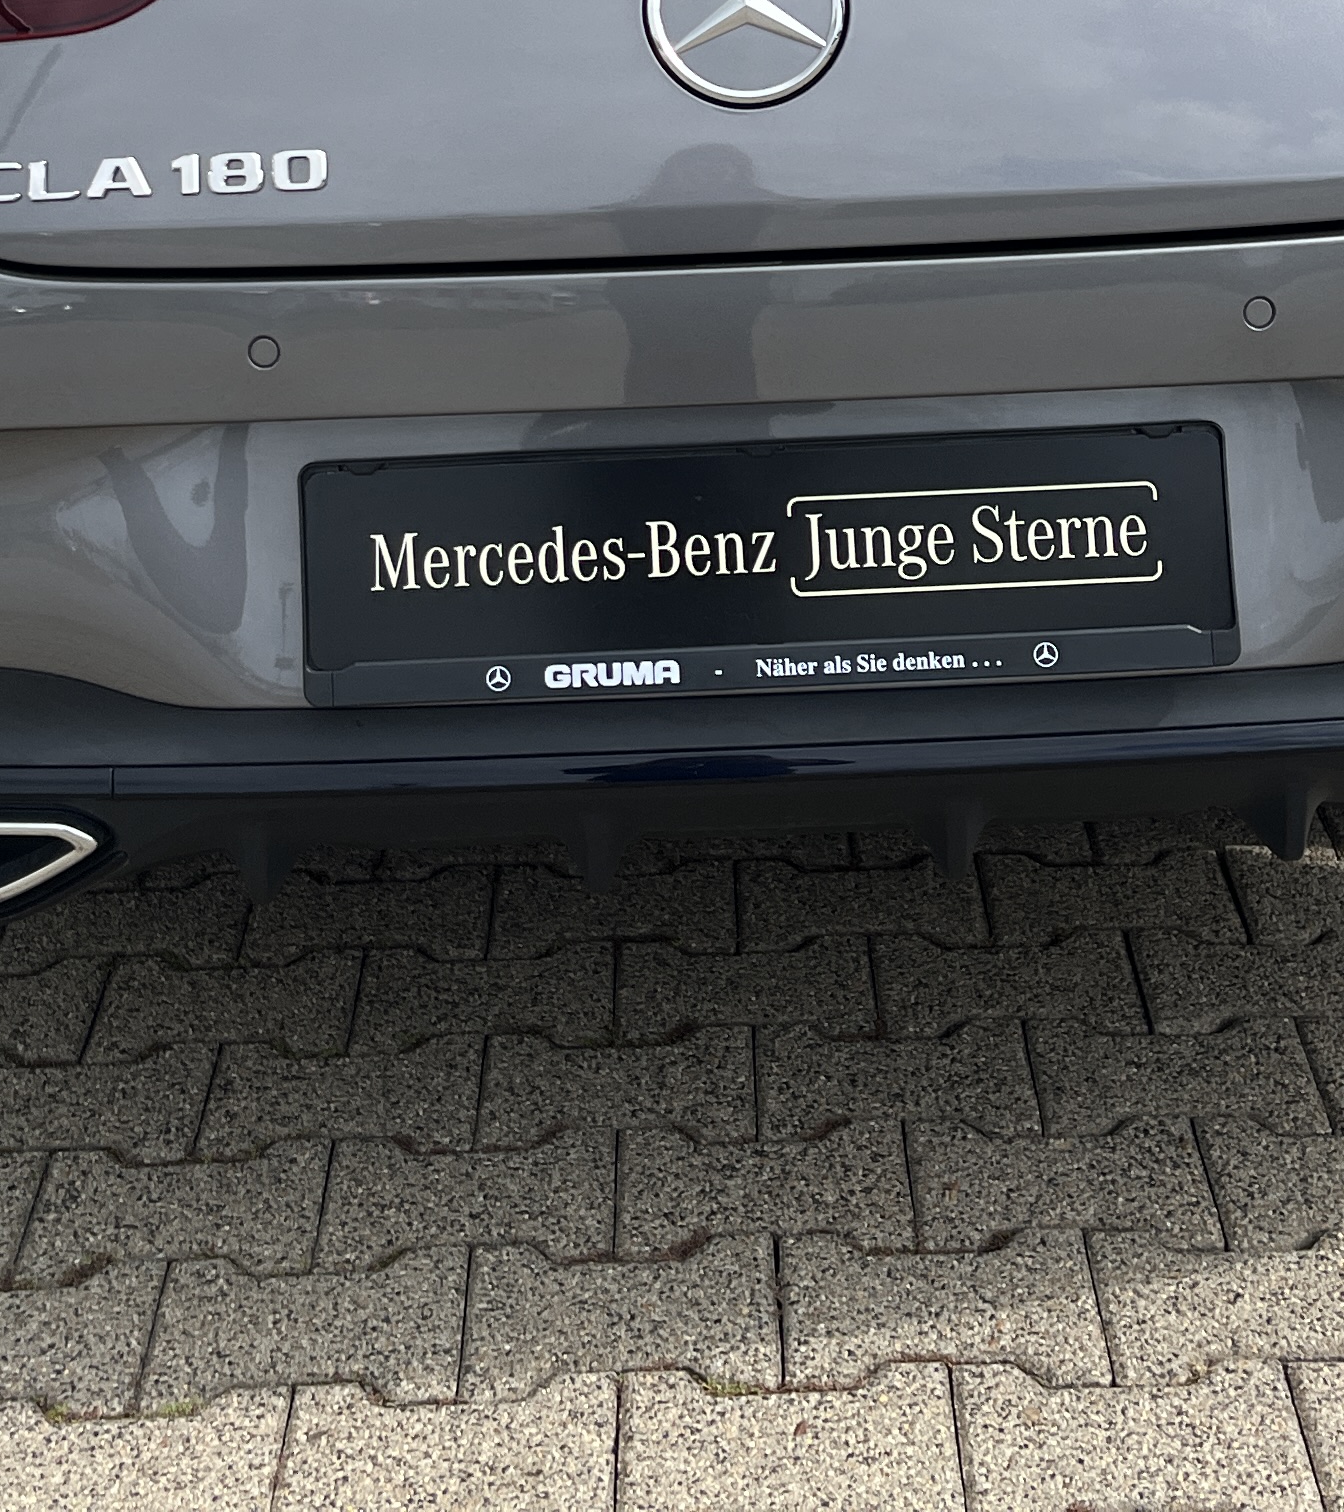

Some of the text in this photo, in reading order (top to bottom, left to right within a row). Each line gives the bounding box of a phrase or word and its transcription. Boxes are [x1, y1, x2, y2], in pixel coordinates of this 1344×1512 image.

[171, 148, 329, 196] 180
[369, 504, 1149, 592] Mercedes-Benz Junge Sterne
[544, 659, 681, 689] GRUMA
[755, 657, 819, 678] Näher
[823, 655, 852, 675] als
[856, 653, 888, 673] Sie
[892, 651, 966, 672] denken
